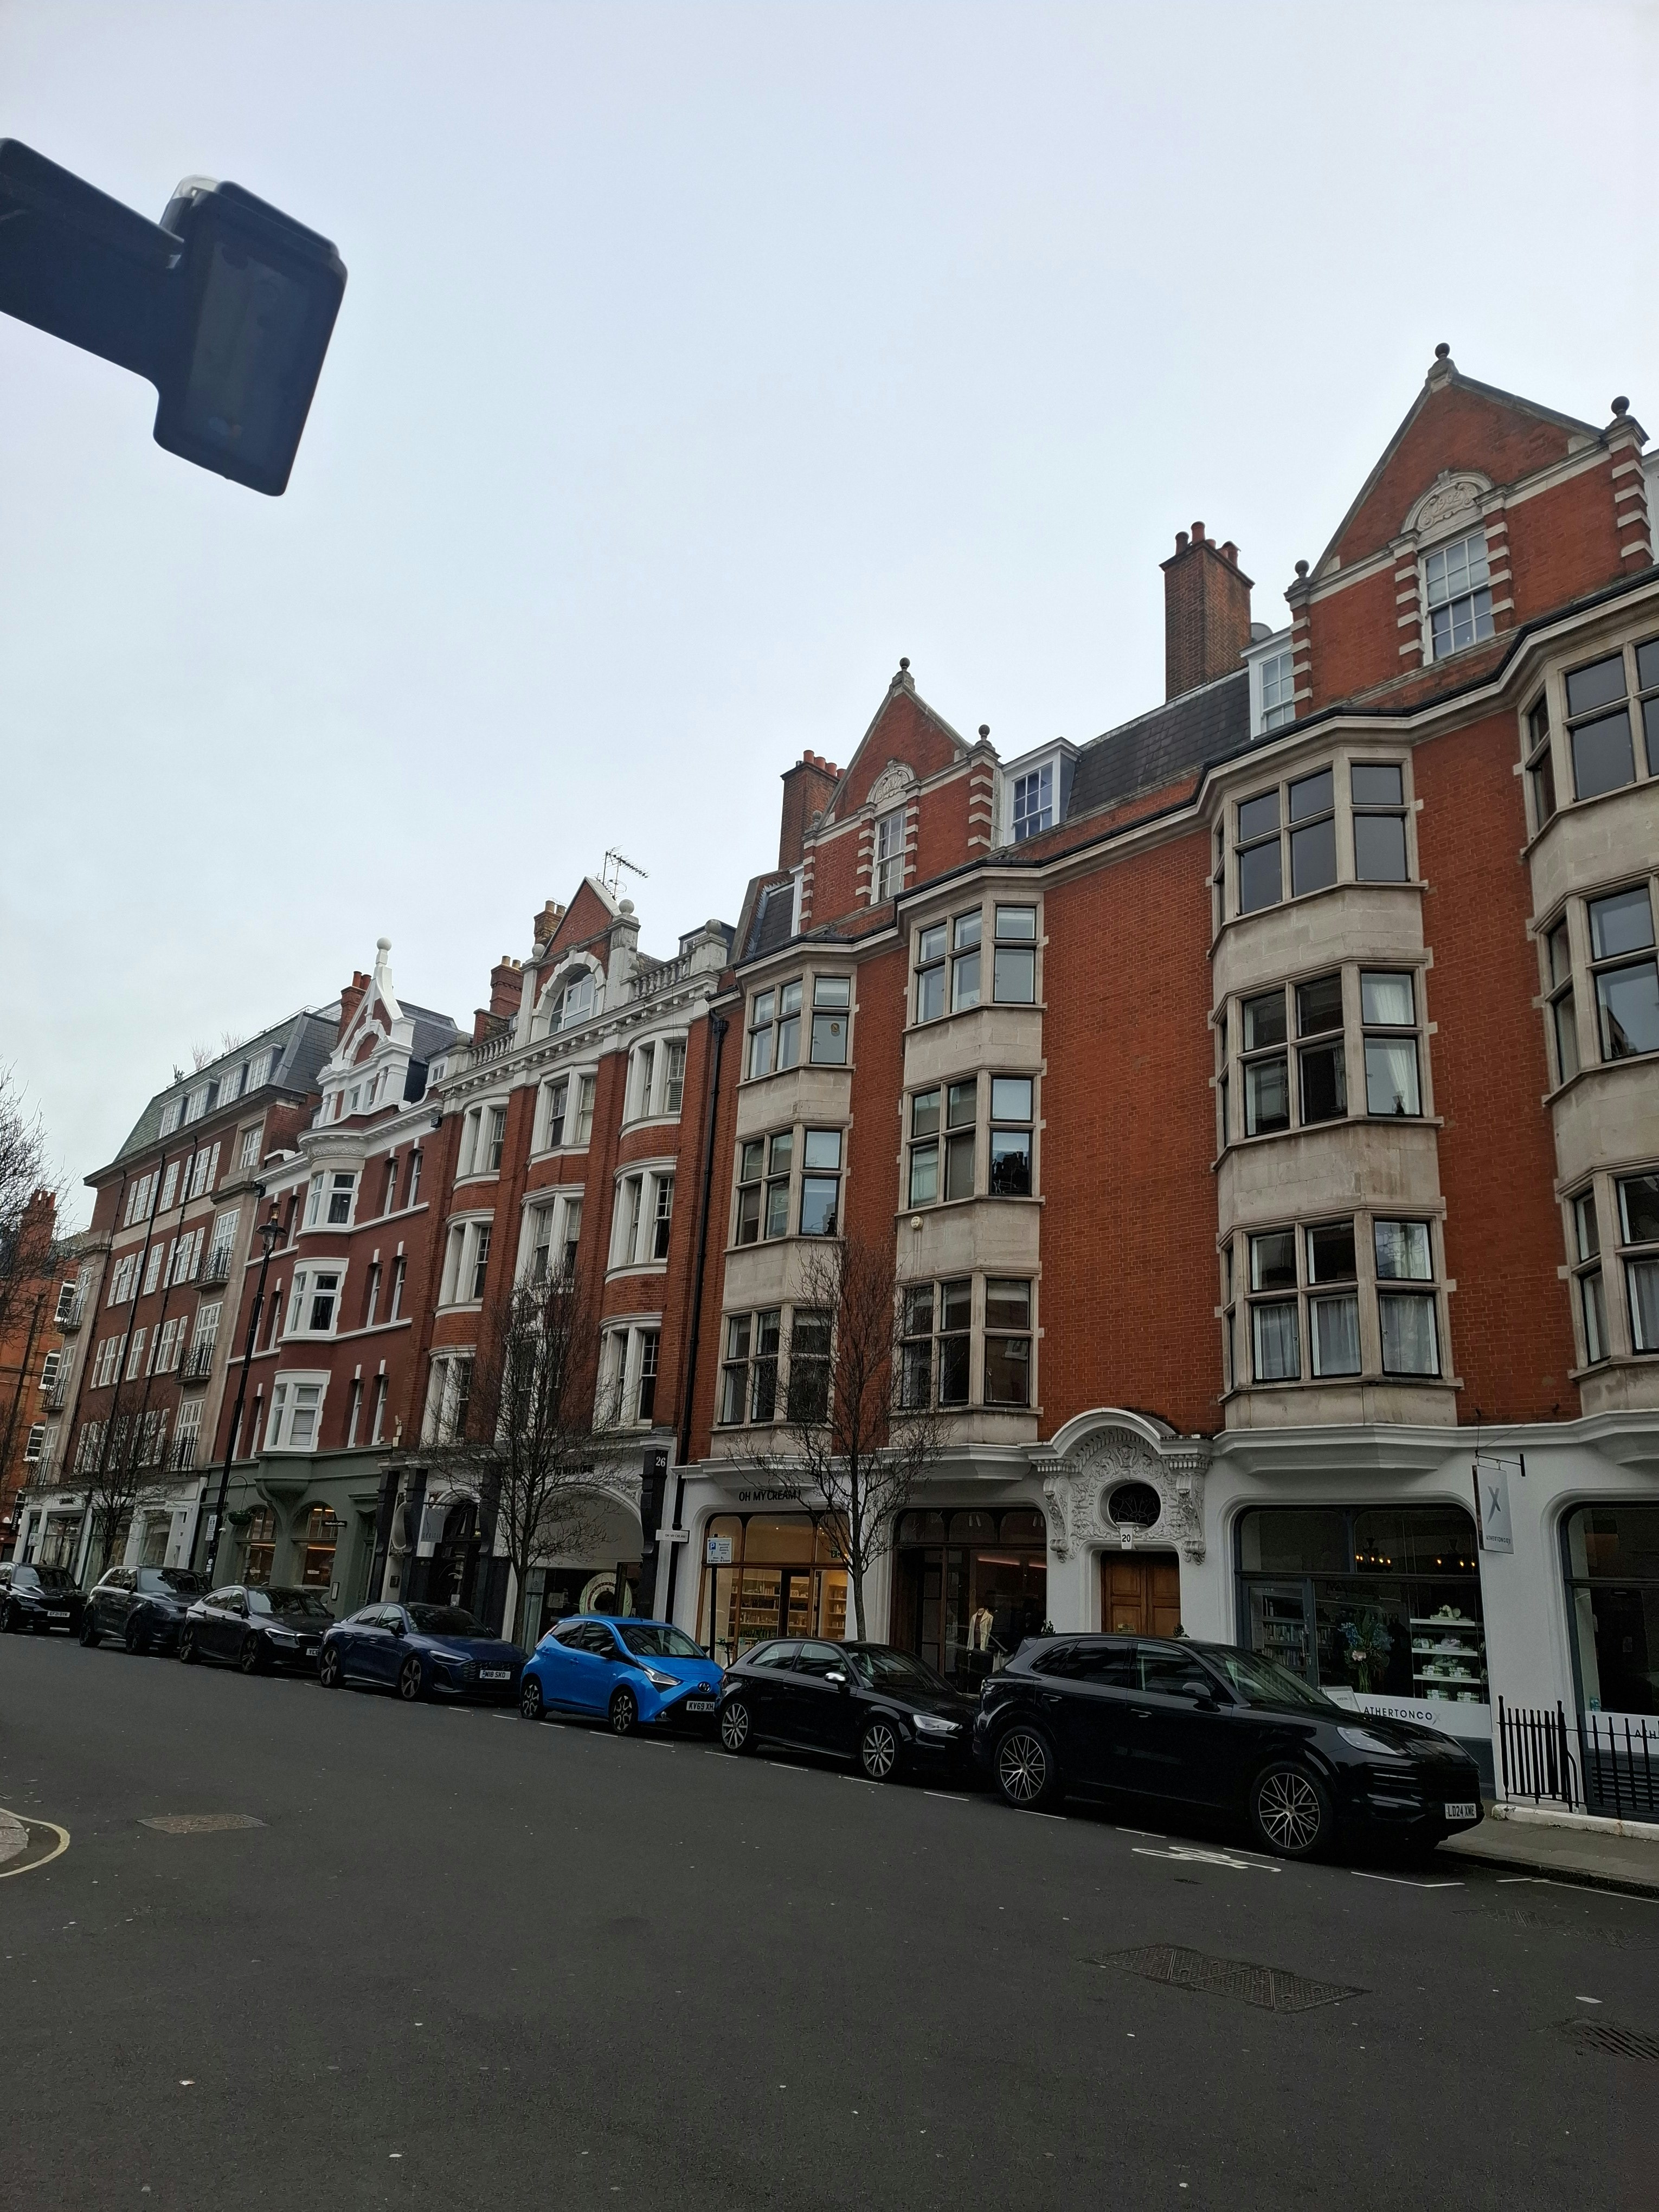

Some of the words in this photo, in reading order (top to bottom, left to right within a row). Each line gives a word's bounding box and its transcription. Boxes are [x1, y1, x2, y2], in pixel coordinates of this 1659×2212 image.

[655, 1456, 666, 1467] 26
[738, 1491, 751, 1501] OH
[753, 1491, 766, 1501] MY
[1122, 1534, 1131, 1542] 20
[689, 1702, 705, 1710] KV69
[1448, 1805, 1463, 1817] LD24
